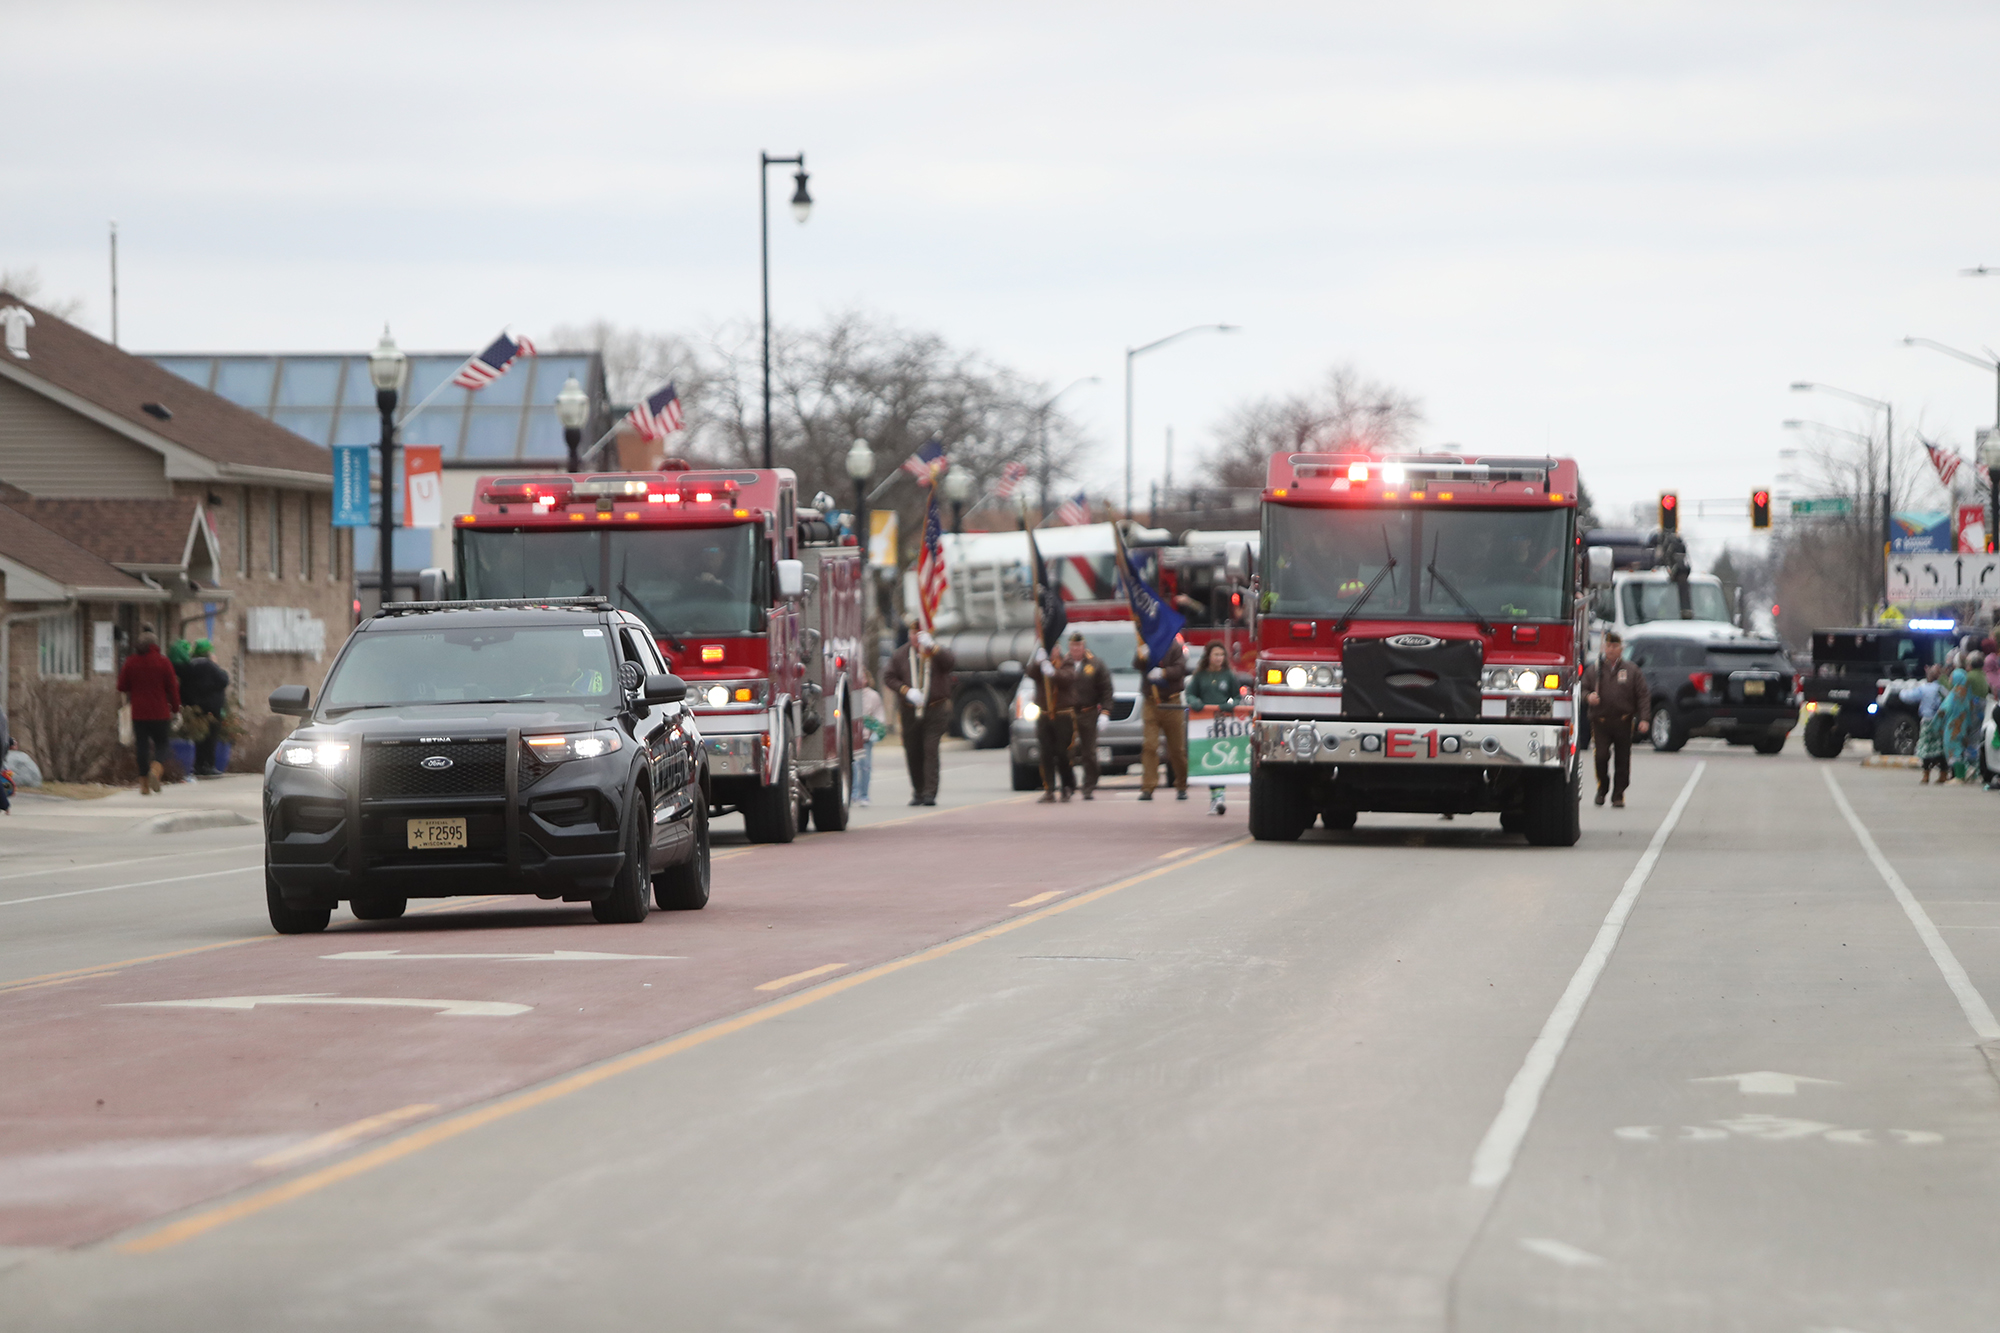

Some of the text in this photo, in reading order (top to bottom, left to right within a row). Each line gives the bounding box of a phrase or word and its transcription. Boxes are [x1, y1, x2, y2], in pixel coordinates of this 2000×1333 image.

[1385, 728, 1438, 758] E1
[428, 759, 446, 767] Ford
[1201, 741, 1239, 769] St.
[429, 826, 462, 841] F2595
